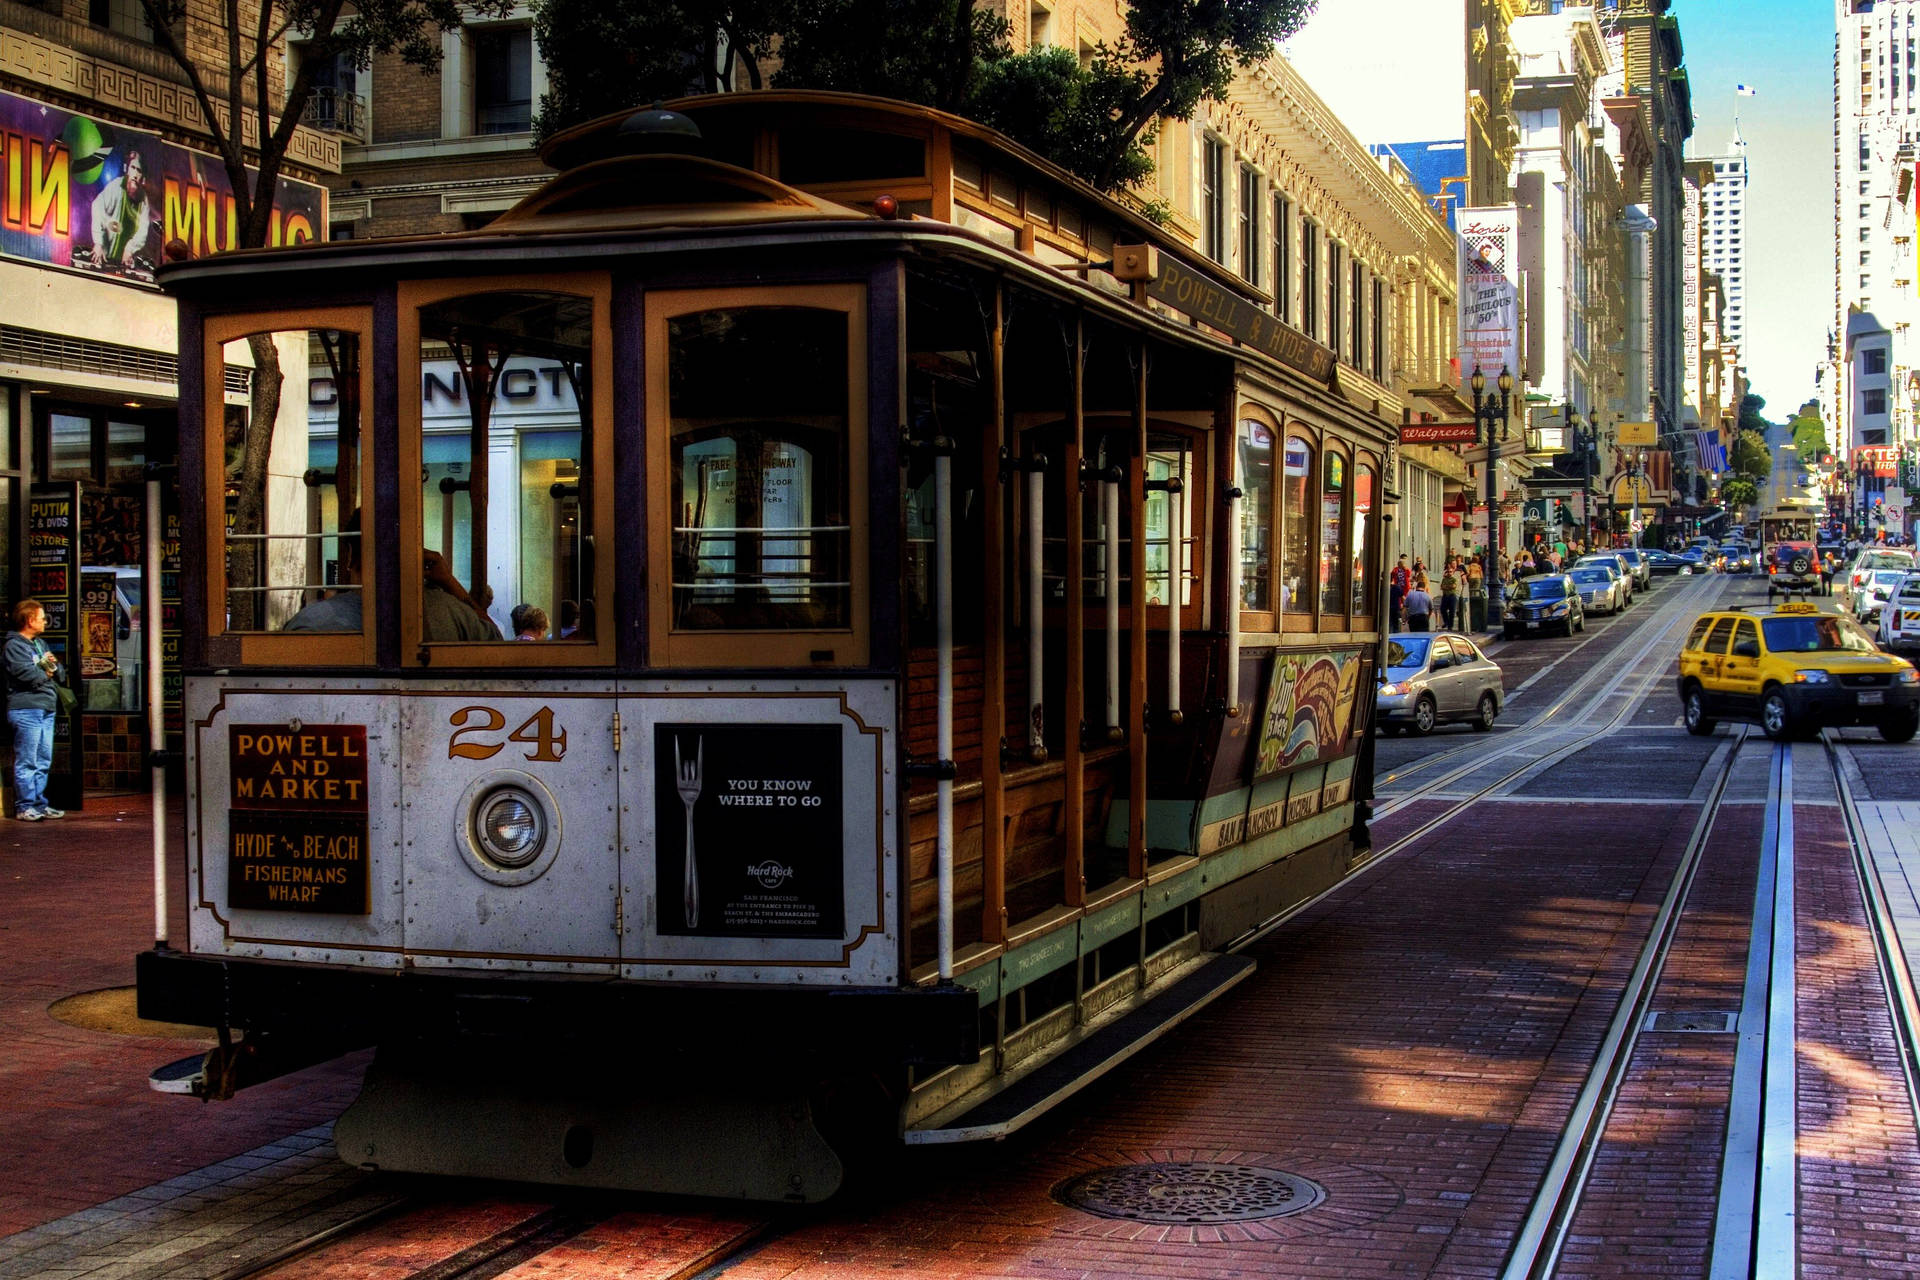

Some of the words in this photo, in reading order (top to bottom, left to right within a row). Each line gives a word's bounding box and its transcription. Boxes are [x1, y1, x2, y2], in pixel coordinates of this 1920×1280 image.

[163, 174, 314, 256] MUIC
[1465, 275, 1507, 285] DINER
[1477, 288, 1497, 301] THE
[1159, 264, 1237, 329] POWELL
[1250, 314, 1262, 342] &
[1268, 325, 1308, 364] HYDE
[1464, 296, 1511, 316] FABULOUS
[1403, 428, 1477, 440] Walgreens
[777, 457, 796, 468] WAY
[31, 502, 69, 517] PUTIN
[47, 517, 68, 528] DVDS
[31, 535, 69, 546] RSTORE
[1782, 604, 1815, 612] YELLOW
[448, 704, 568, 763] 24
[238, 734, 359, 757] POWELL
[270, 759, 329, 776] AND
[236, 778, 363, 801] MARKET
[728, 779, 759, 791] YOU
[762, 779, 812, 791] KNOW
[718, 795, 774, 807] WHERE
[777, 795, 798, 807] TO
[801, 795, 822, 807] GO
[1218, 820, 1237, 847] SAN
[1237, 805, 1278, 841] FANCISCO
[235, 833, 276, 858] HYDE
[280, 835, 300, 858] AND
[303, 835, 358, 860] BEACH
[244, 865, 347, 884] FISHERMANS
[747, 865, 769, 877] Hard
[771, 865, 794, 878] Rock
[268, 885, 321, 902] WHARF
